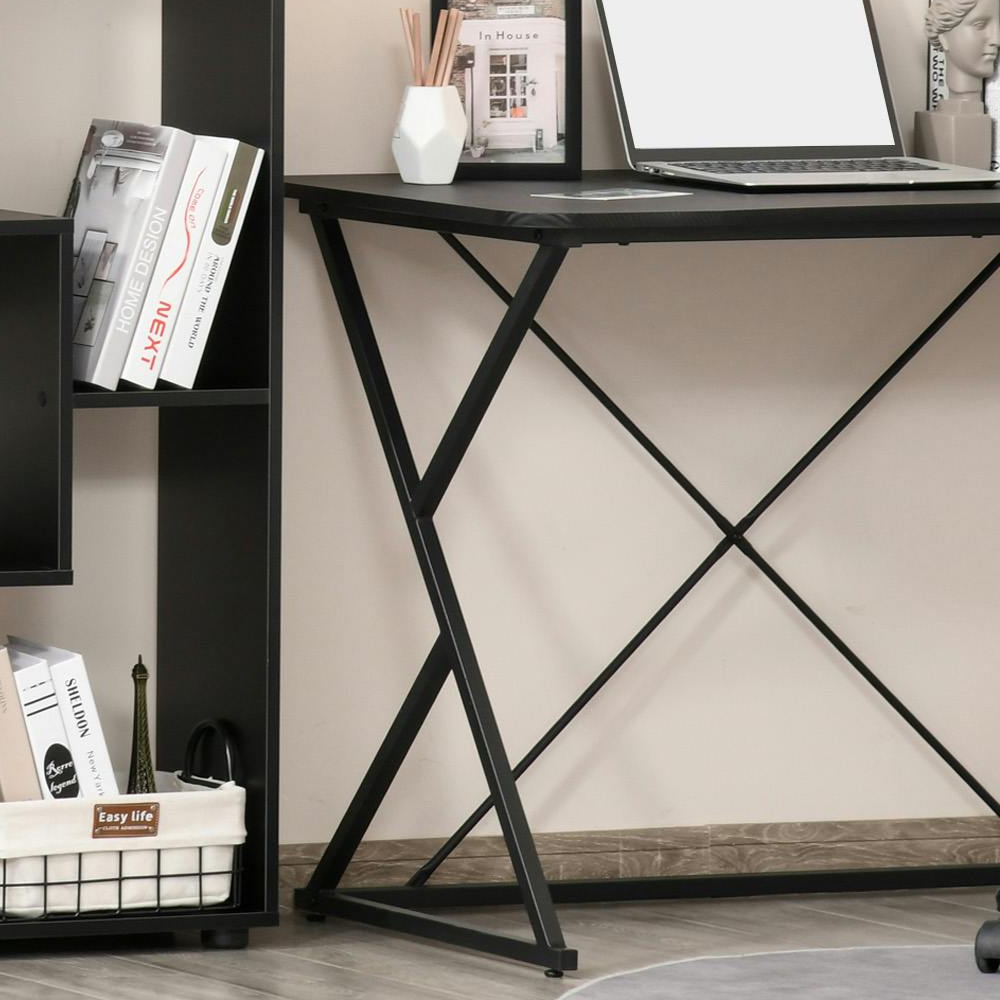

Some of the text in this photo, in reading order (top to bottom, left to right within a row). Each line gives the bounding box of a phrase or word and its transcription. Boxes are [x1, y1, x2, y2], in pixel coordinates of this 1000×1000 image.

[479, 31, 539, 40] In House
[116, 207, 167, 334] HOME DESIGN
[141, 301, 171, 370] NEXT
[188, 316, 202, 349] WORLD
[64, 677, 91, 739] SHELDON
[87, 750, 97, 772] New
[99, 810, 154, 825] Easy life
